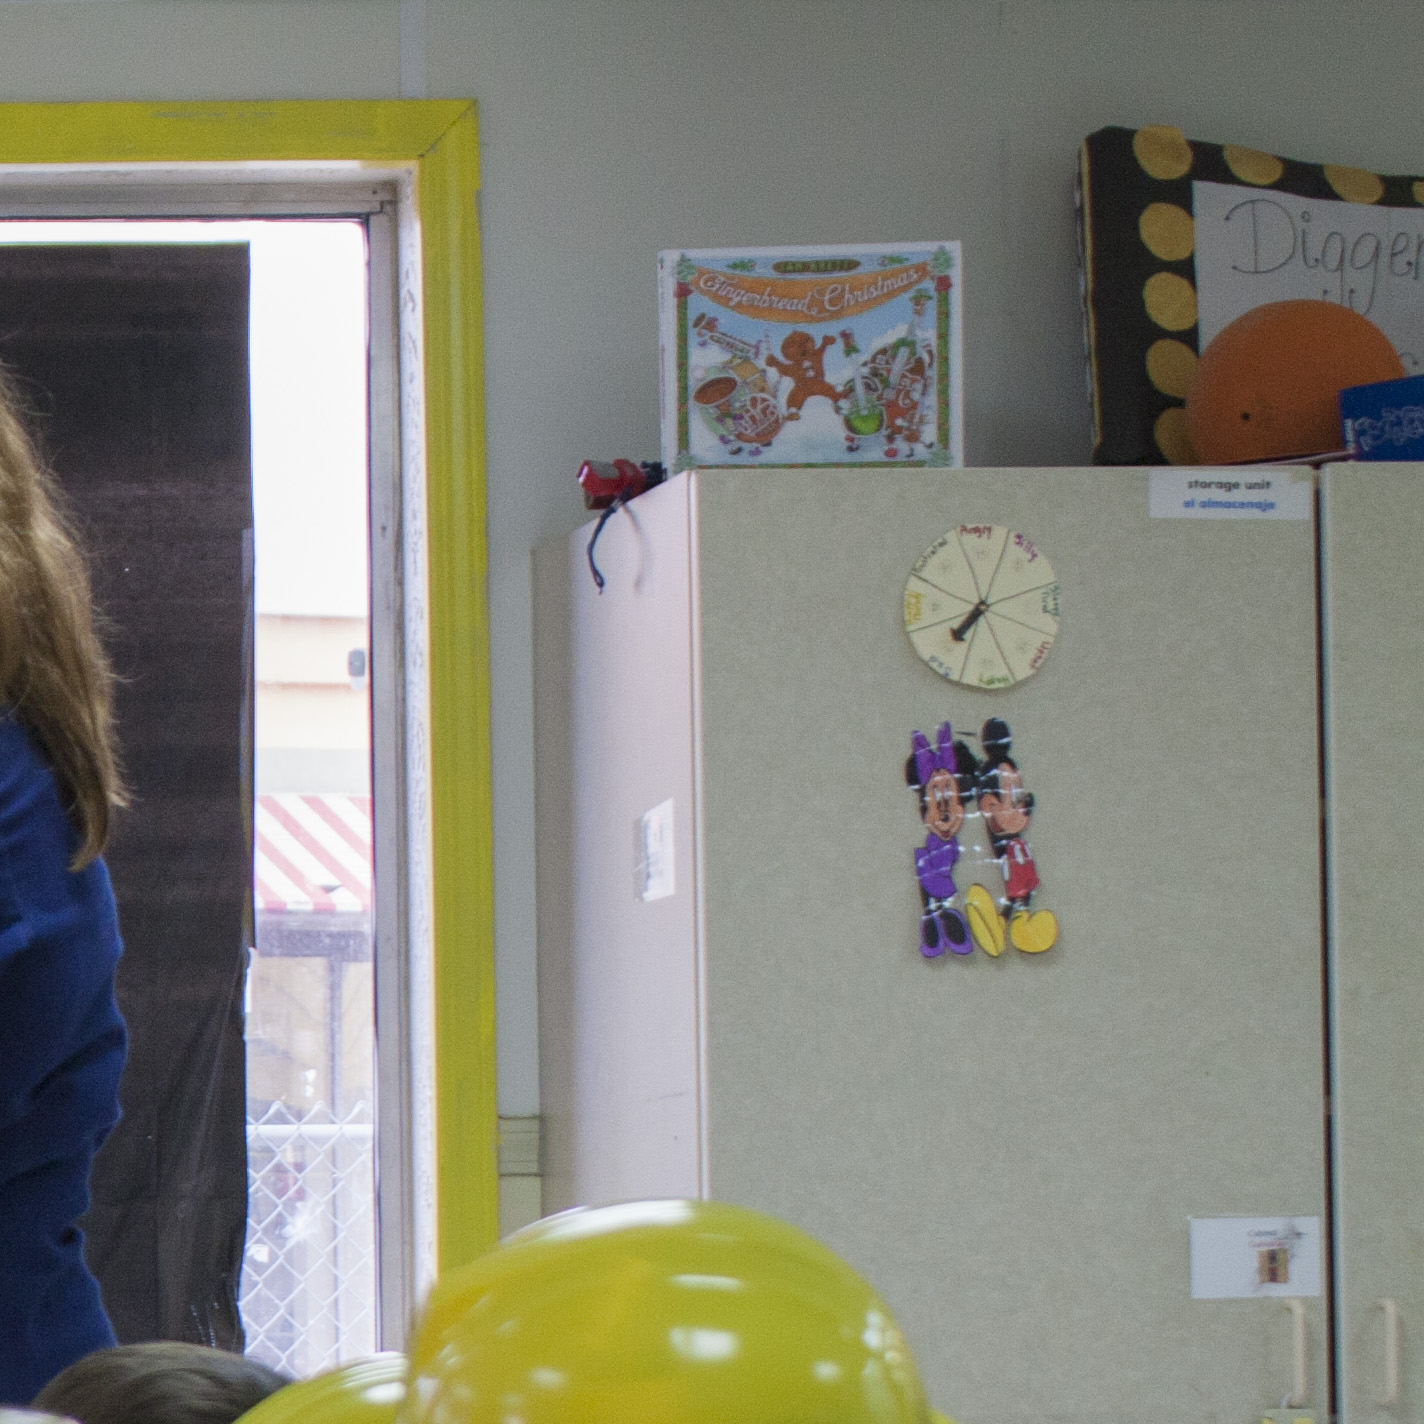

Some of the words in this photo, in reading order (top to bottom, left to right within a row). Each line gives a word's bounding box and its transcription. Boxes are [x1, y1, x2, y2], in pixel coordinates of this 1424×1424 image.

[699, 272, 814, 315] Gingerbread
[822, 270, 922, 311] Christmas
[1187, 479, 1240, 491] storage
[1244, 480, 1270, 490] unit
[1183, 499, 1195, 509] el
[1199, 499, 1275, 512] almacenaje
